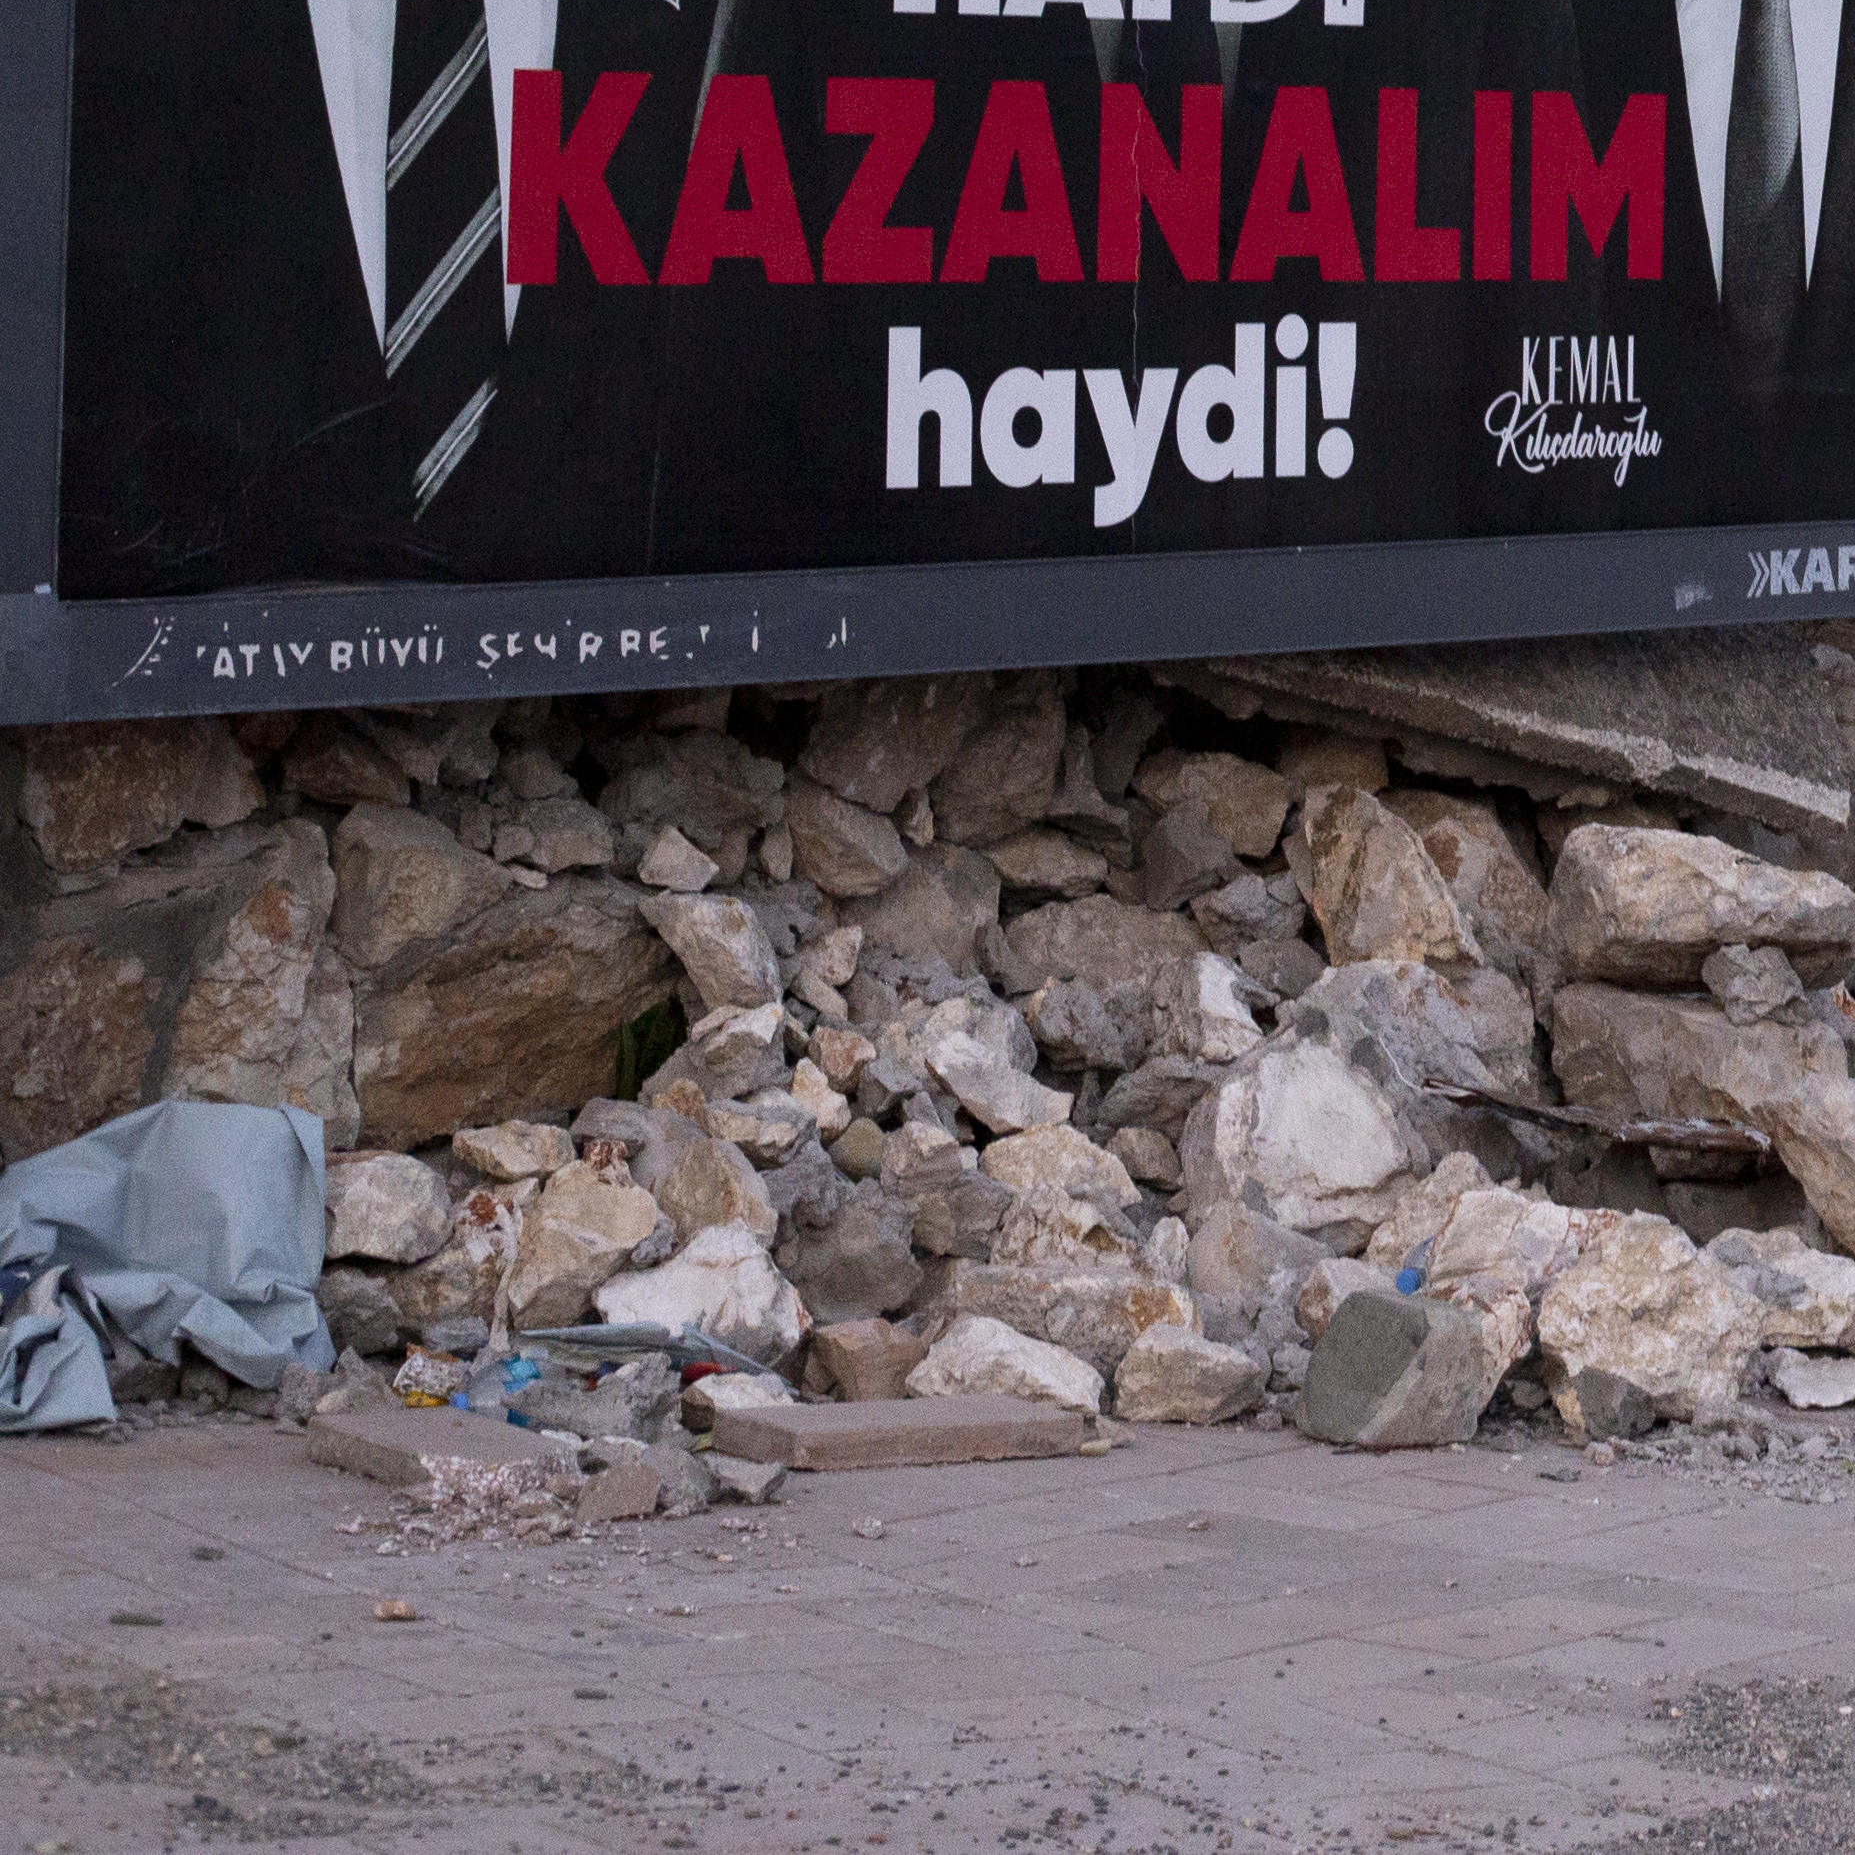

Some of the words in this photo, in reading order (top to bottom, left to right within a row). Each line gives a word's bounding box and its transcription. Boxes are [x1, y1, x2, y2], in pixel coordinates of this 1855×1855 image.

[506, 68, 1668, 286] KAZANALIM
[885, 314, 1357, 527] haydi!
[1521, 334, 1642, 406] KEMAL
